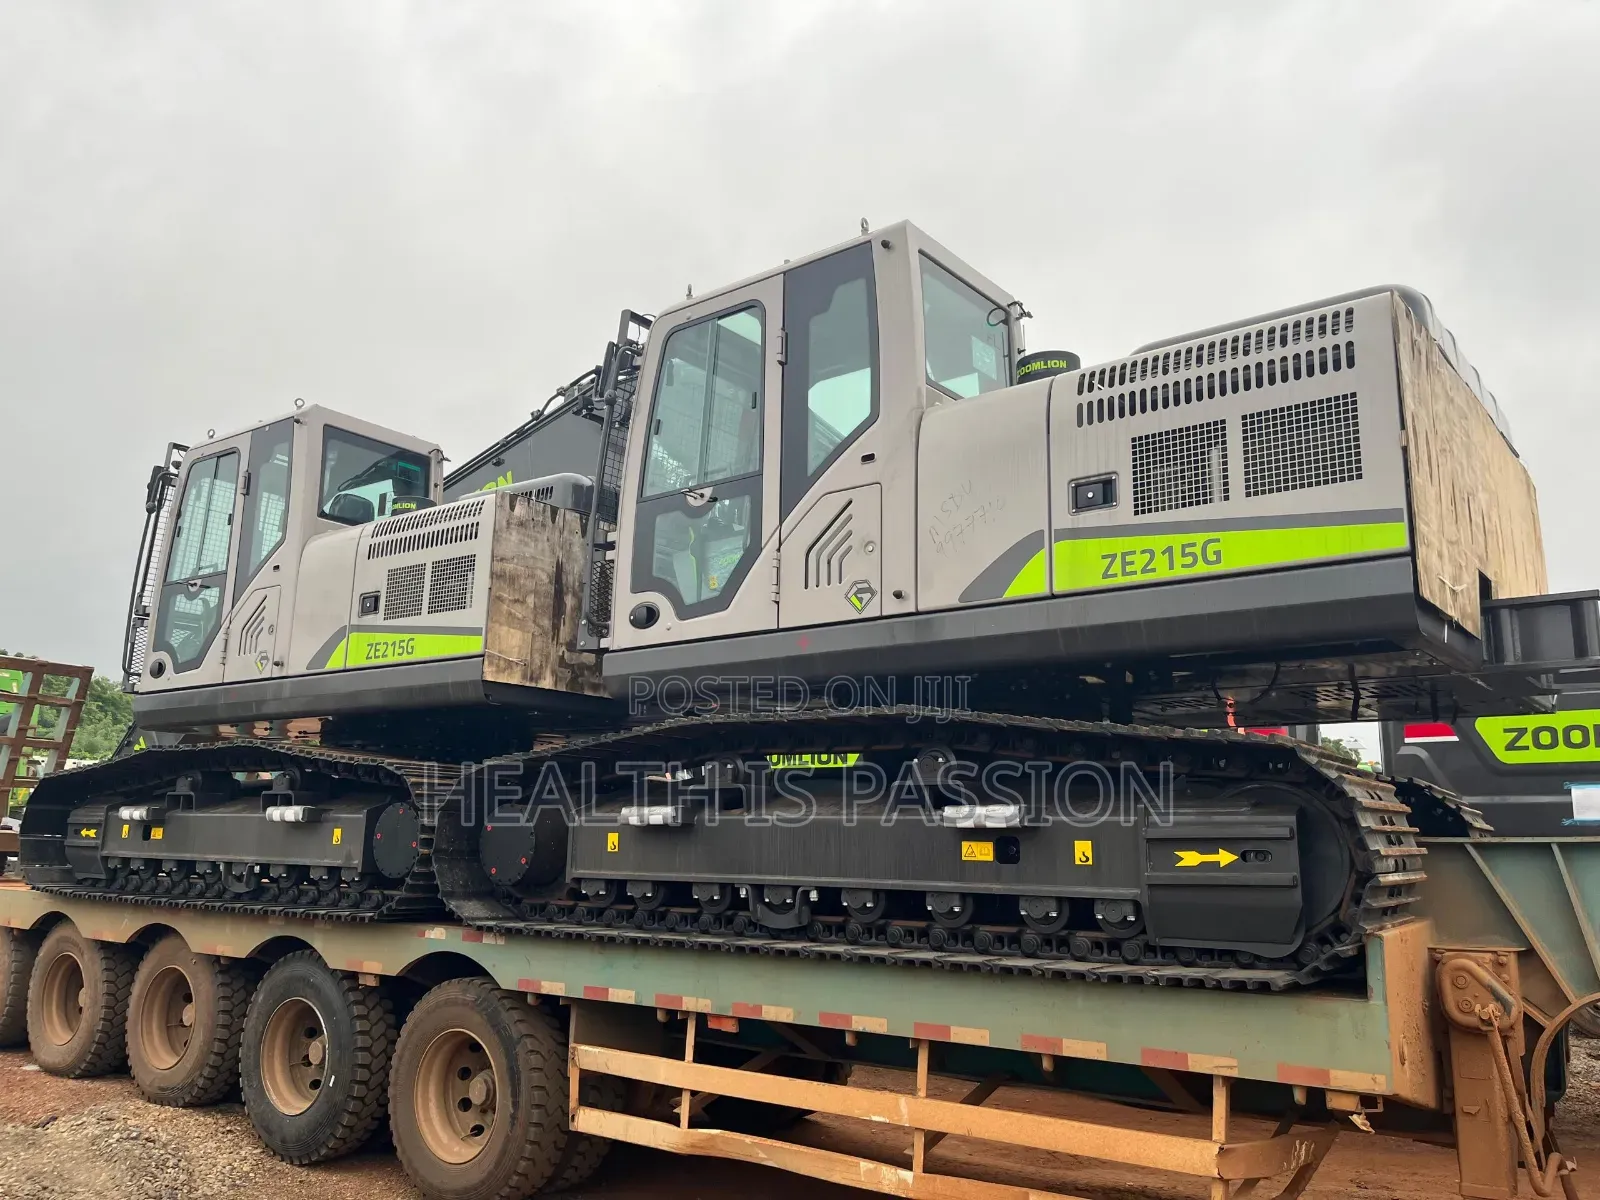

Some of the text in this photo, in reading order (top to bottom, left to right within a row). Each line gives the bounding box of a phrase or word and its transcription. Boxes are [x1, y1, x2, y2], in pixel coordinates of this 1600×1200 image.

[1100, 537, 1222, 580] ZE215G
[365, 637, 416, 660] ZE215G
[1502, 724, 1600, 752] ZOO
